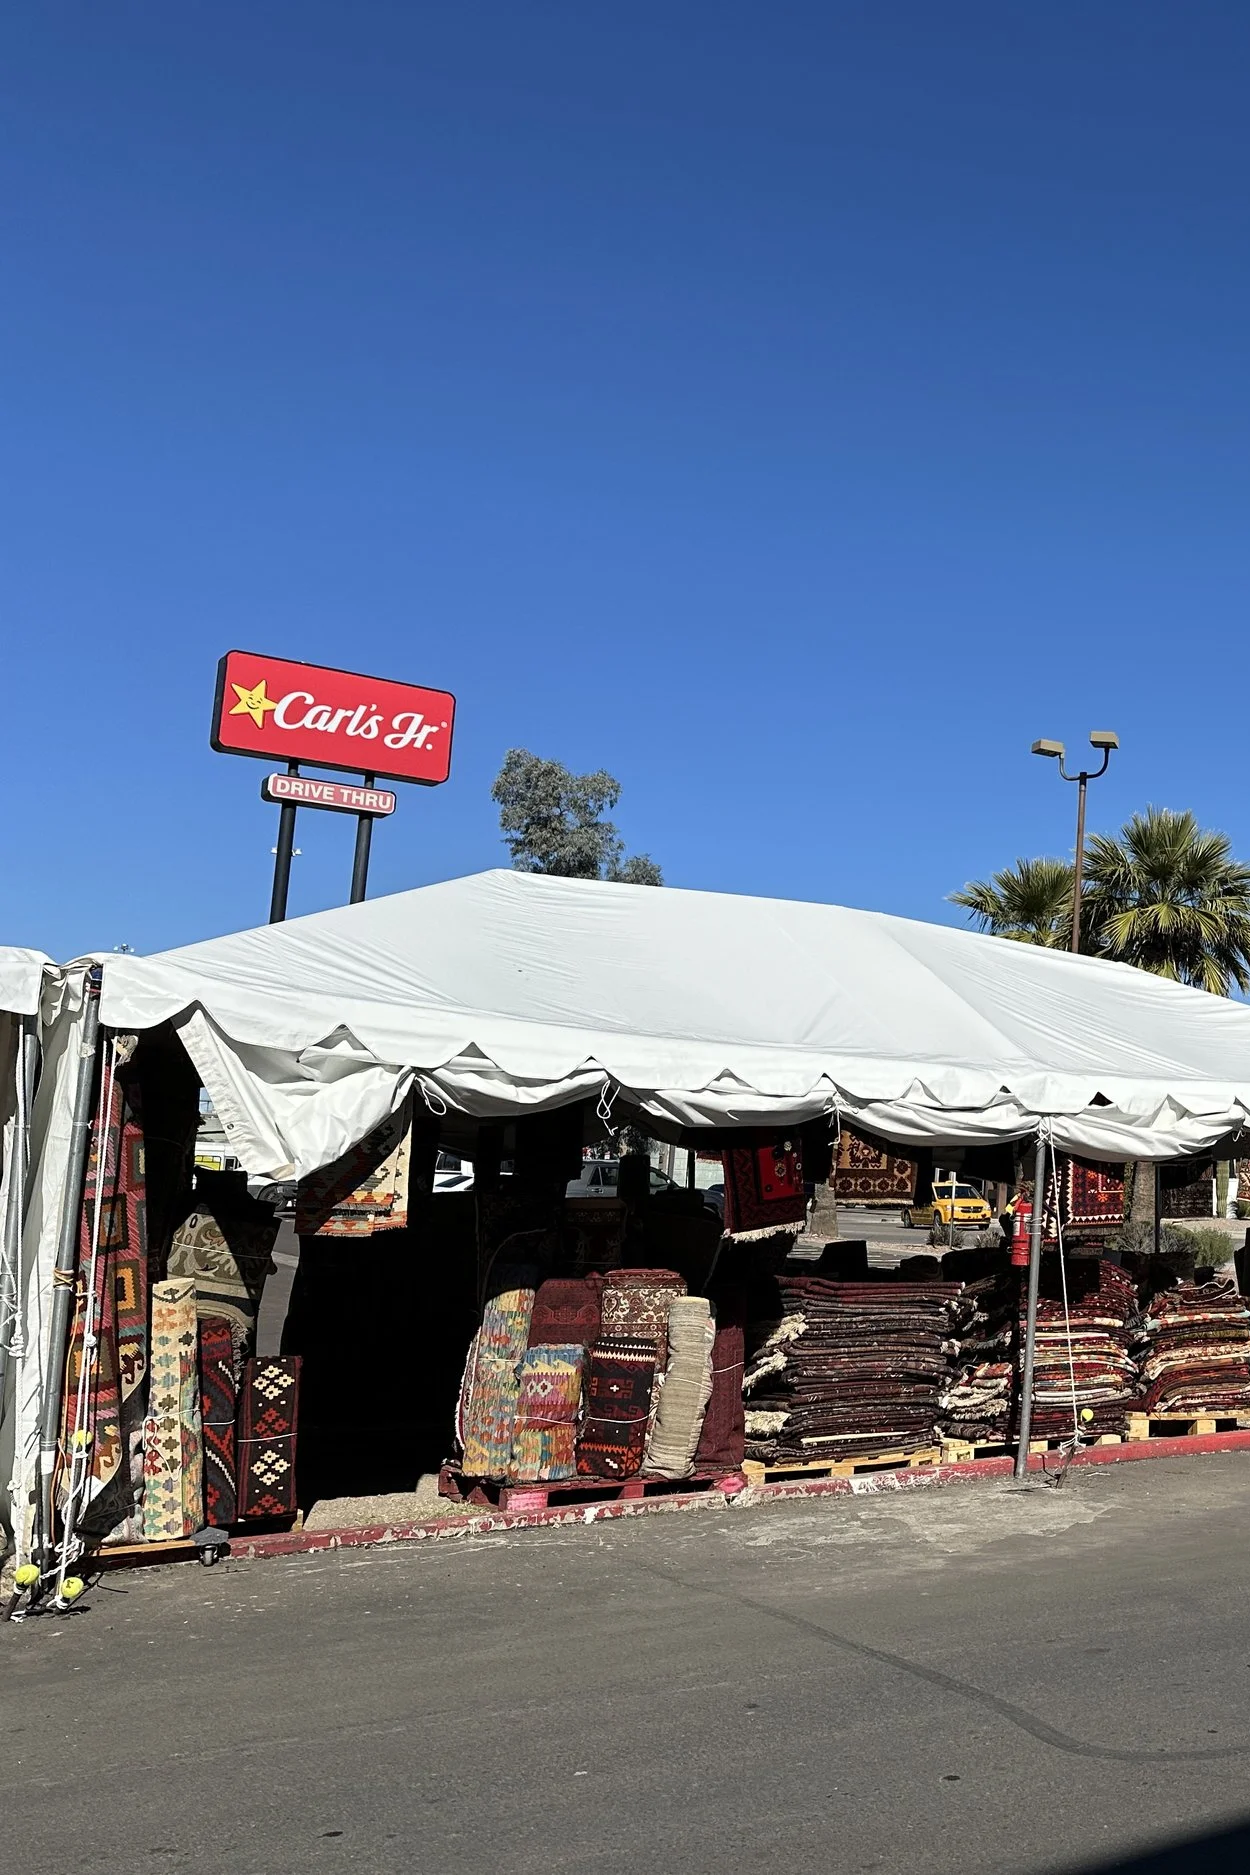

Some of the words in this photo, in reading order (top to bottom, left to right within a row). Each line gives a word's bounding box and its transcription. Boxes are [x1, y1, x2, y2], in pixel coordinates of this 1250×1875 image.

[272, 691, 384, 740] Carl's
[383, 712, 440, 751] Jr.
[275, 779, 336, 801] DRIVE
[339, 788, 393, 810] THRU
